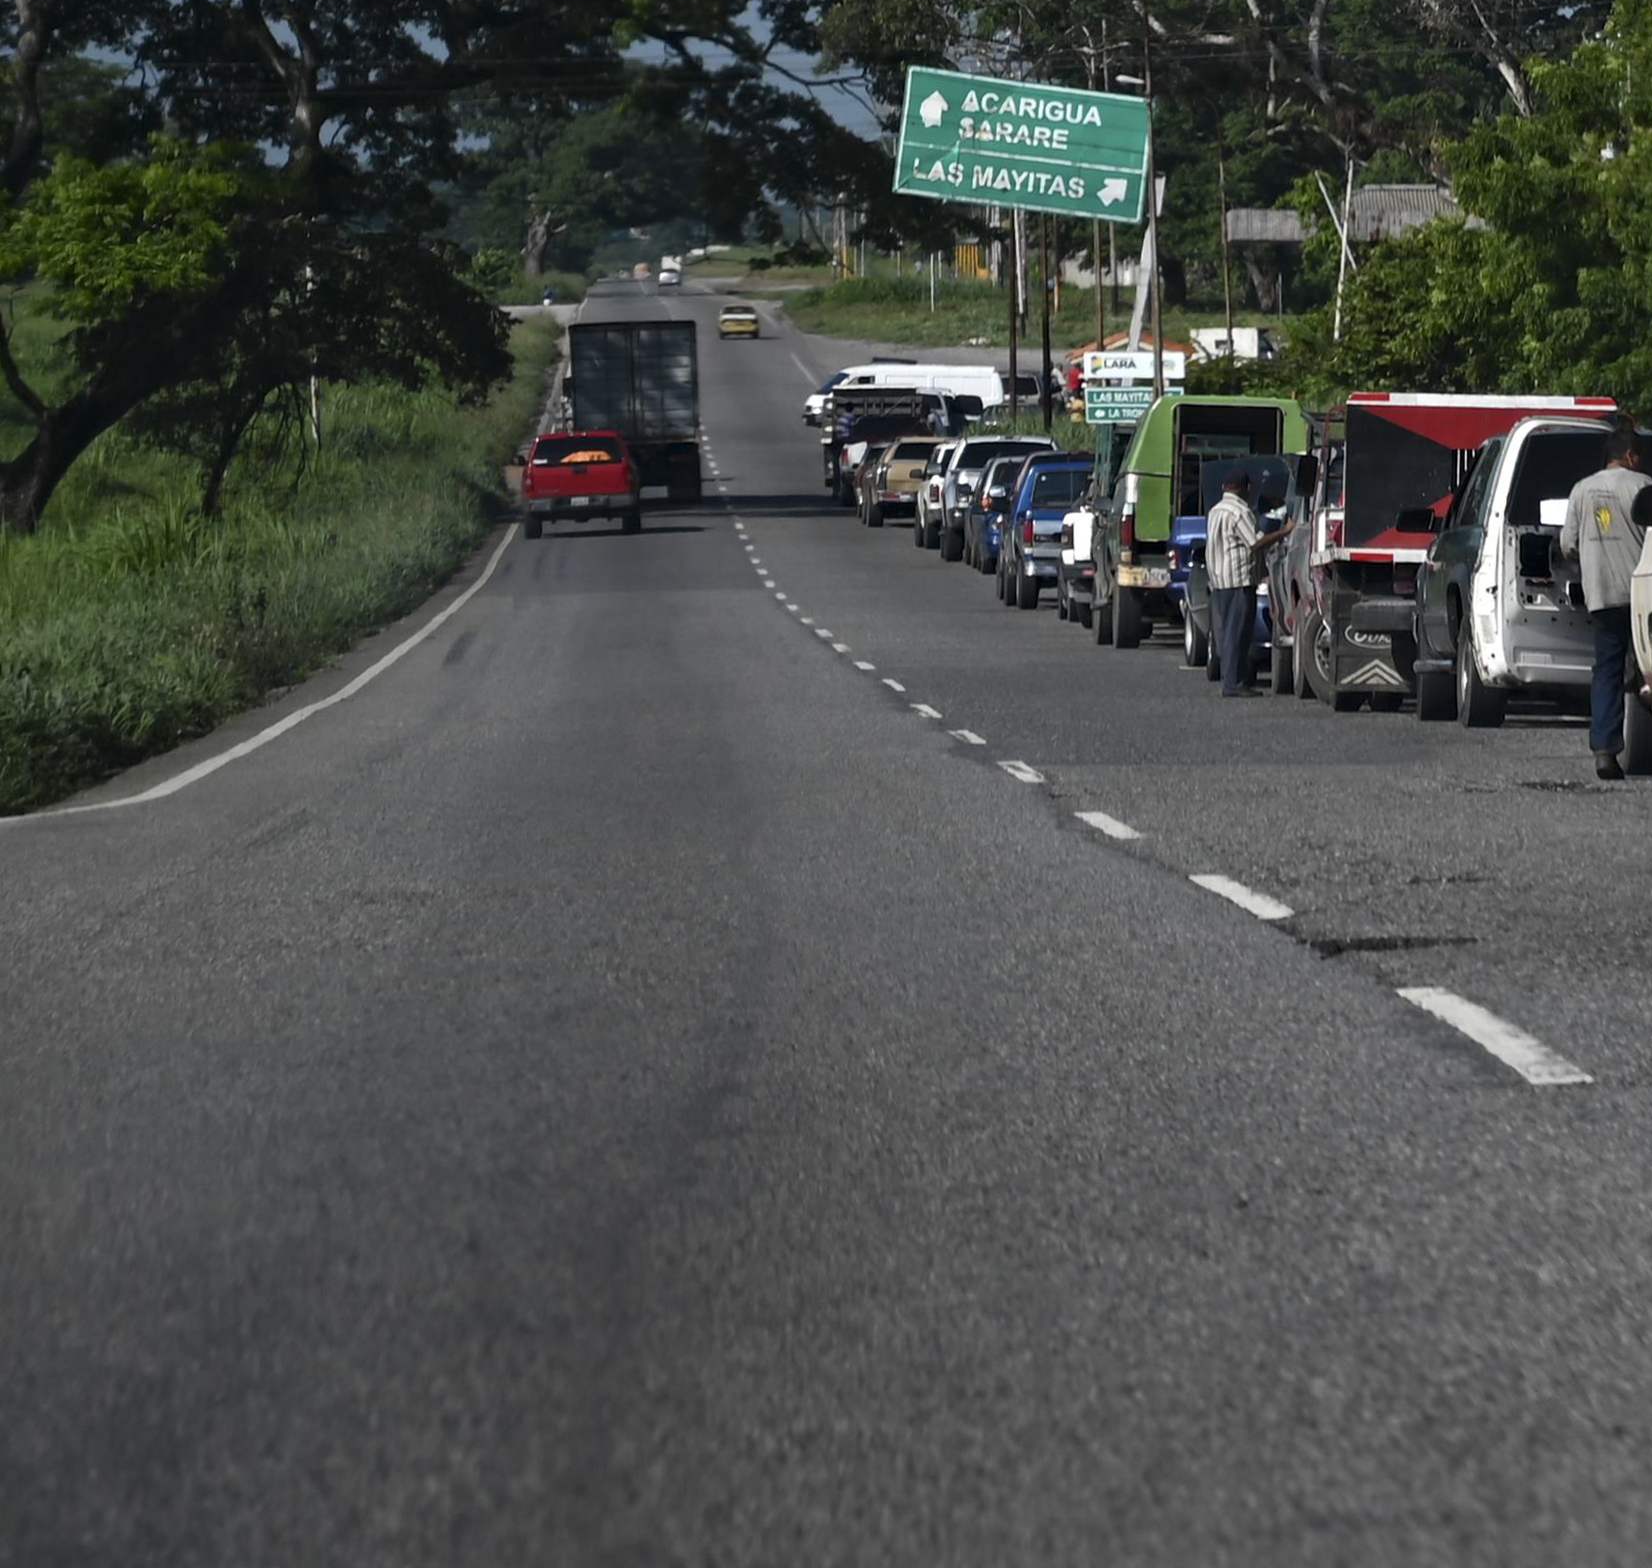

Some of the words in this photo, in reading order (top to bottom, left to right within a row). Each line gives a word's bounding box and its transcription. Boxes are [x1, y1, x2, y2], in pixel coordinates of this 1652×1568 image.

[961, 89, 1102, 127] ACARIGUA
[959, 116, 1069, 150] SARARE
[913, 157, 964, 187] LAS
[972, 164, 1085, 199] MAYITAS
[1104, 359, 1136, 369] LARA
[1093, 393, 1111, 402] LAS
[1108, 408, 1119, 417] LA
